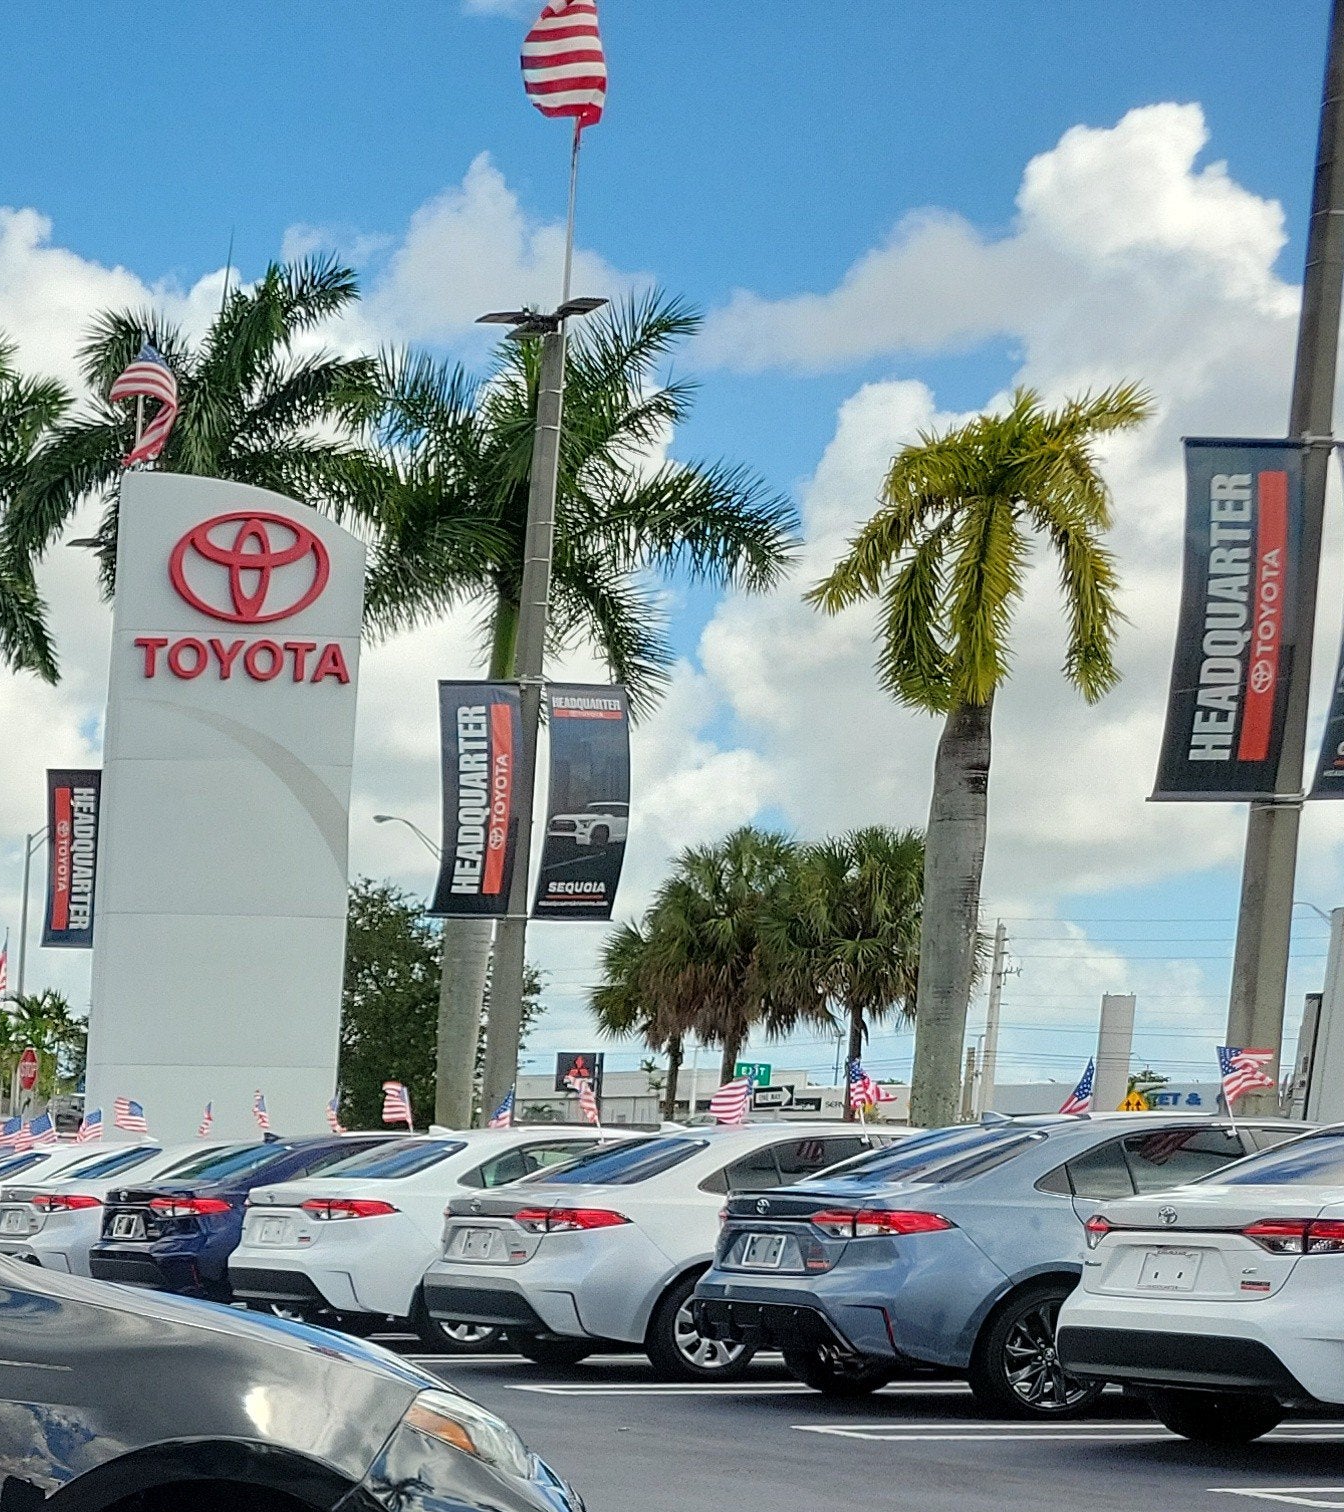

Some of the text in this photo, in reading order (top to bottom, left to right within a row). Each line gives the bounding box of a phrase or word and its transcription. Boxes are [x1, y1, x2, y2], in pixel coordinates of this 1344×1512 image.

[1188, 473, 1253, 761] HEADQUARTER
[1255, 548, 1281, 657] TOYOTA
[134, 637, 350, 684] TOYOTA
[552, 697, 621, 711] HEADQUARTER
[450, 704, 489, 895] HEADQUARTER
[490, 753, 509, 824] TOYOTA
[57, 839, 69, 892] TOYOTA
[68, 787, 96, 929] HEADQUARTER
[548, 882, 606, 894] SEQUOIA
